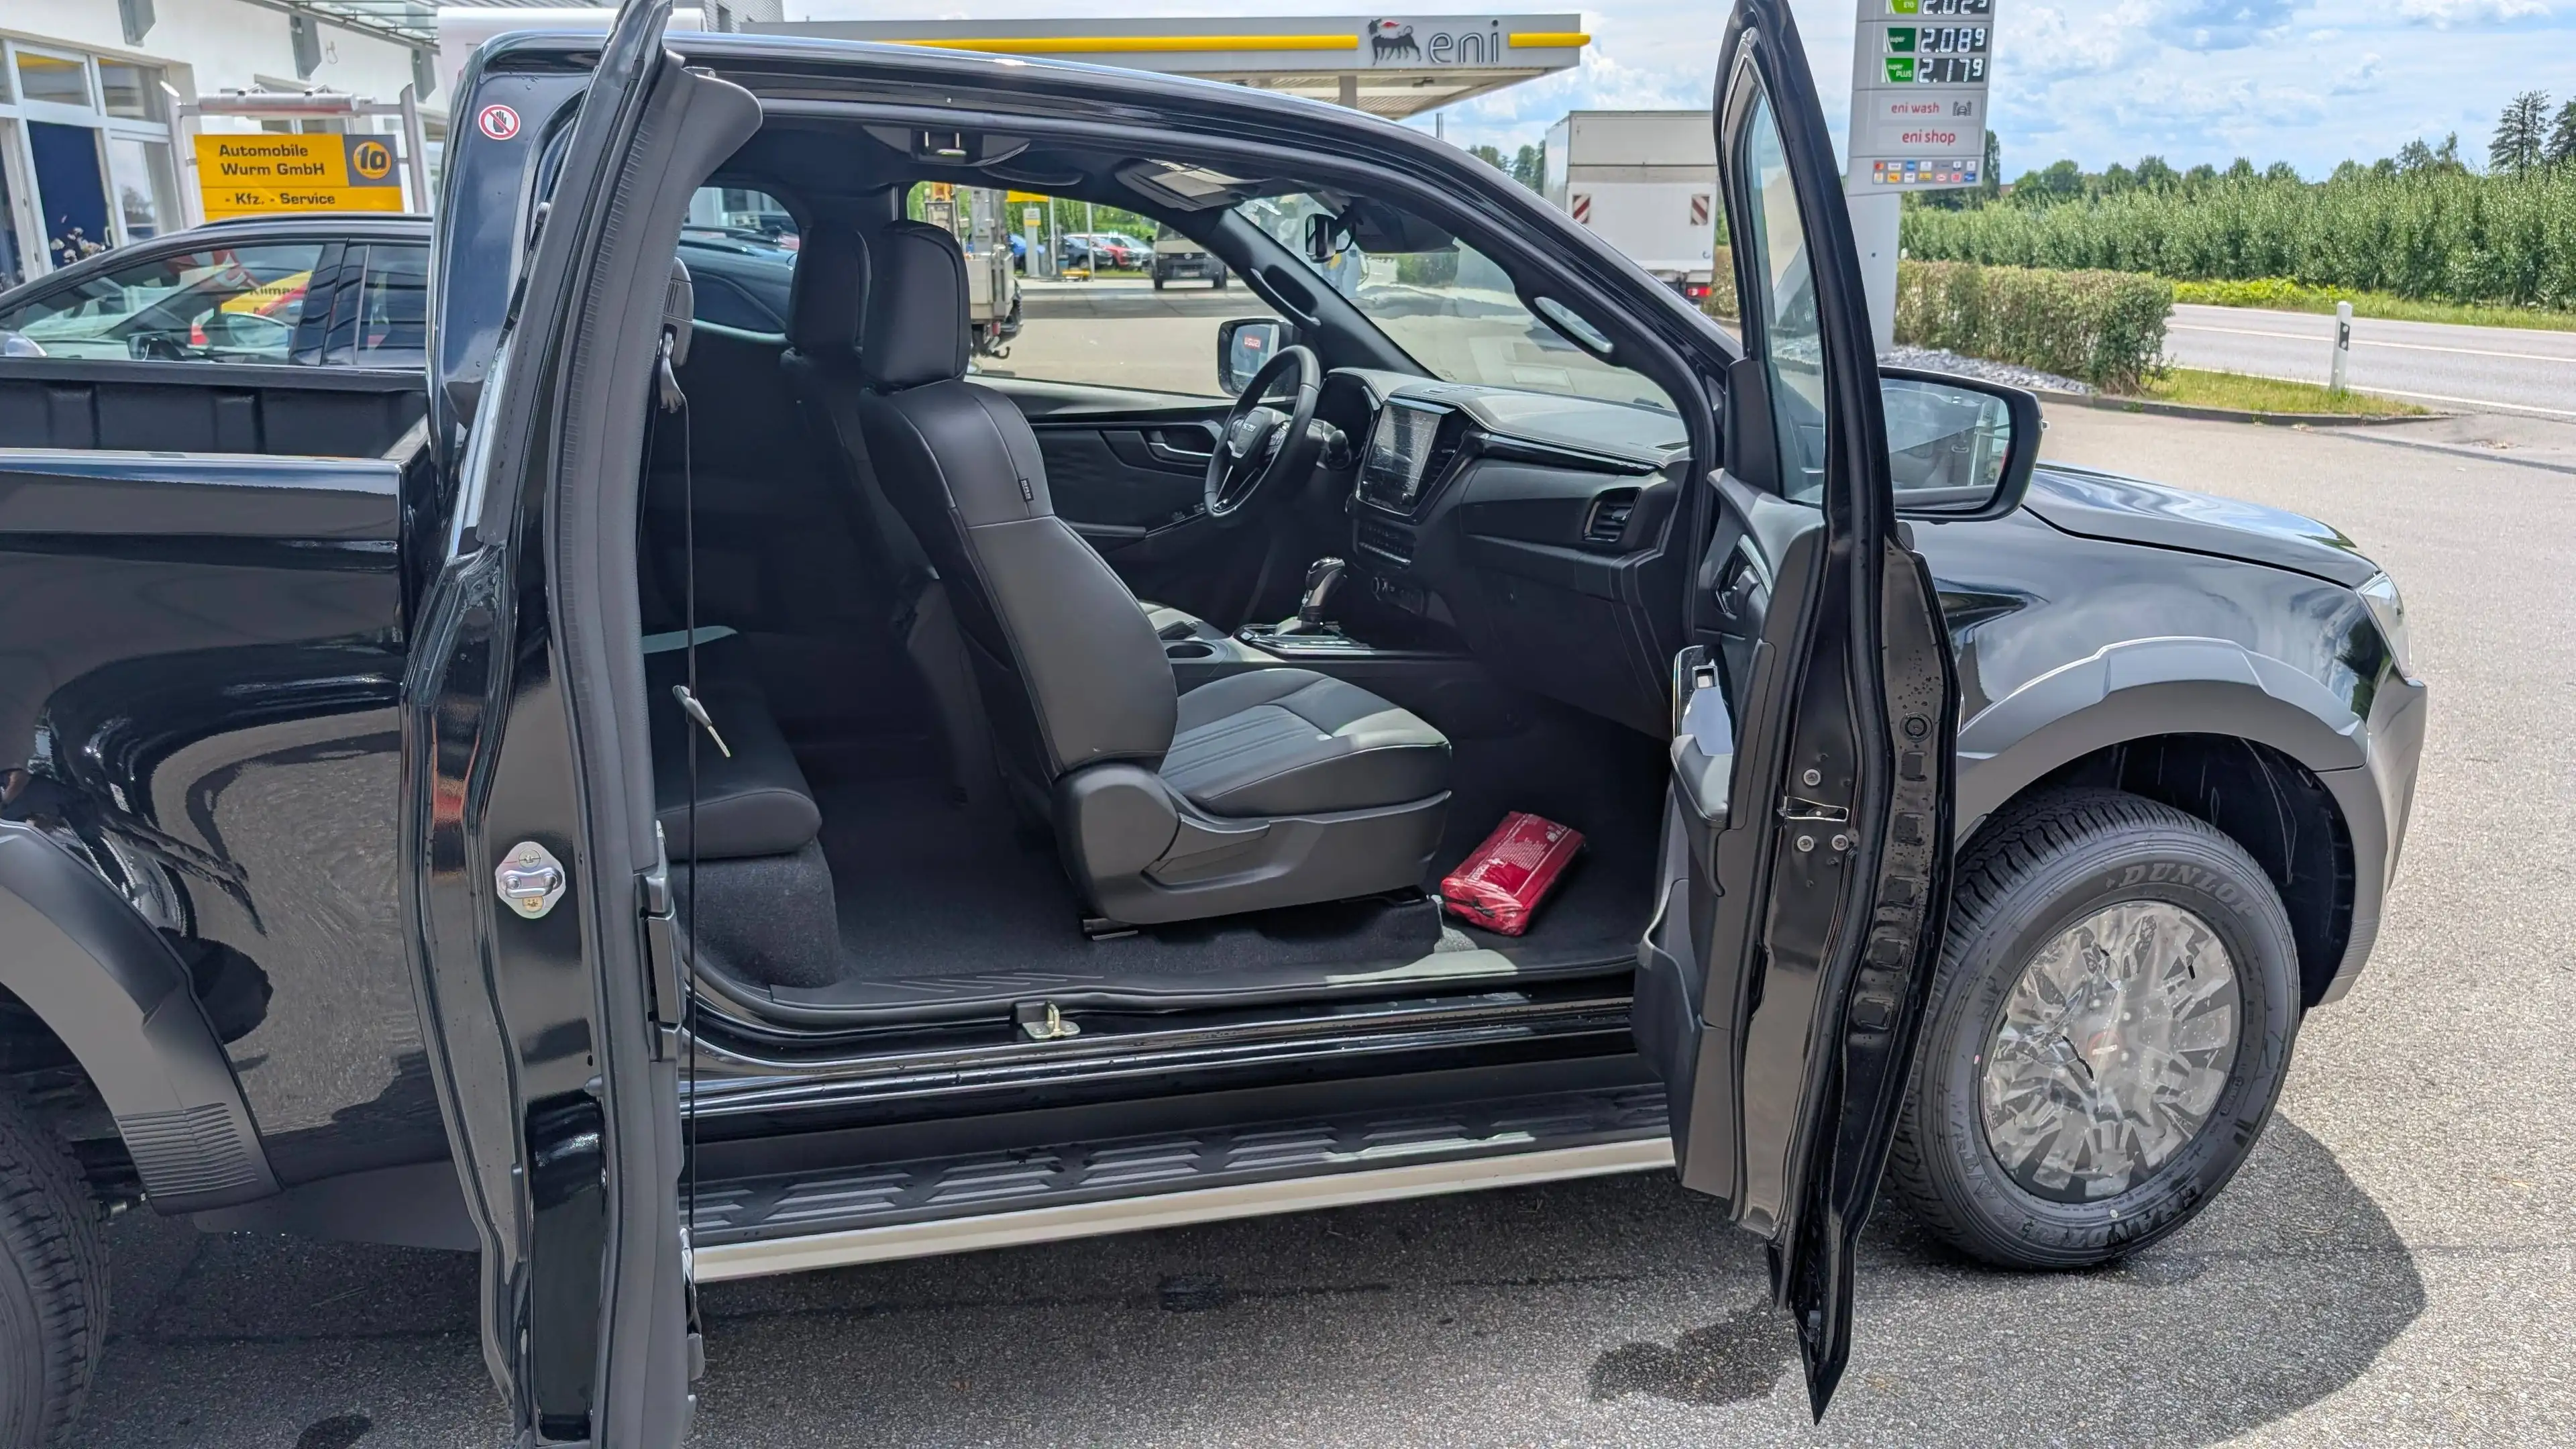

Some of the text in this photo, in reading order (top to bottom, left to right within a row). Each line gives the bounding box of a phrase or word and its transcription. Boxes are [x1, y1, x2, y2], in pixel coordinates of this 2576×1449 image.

[1428, 19, 1499, 64] eni
[1920, 28, 1986, 53] 2.089
[1918, 58, 1984, 83] 2.179
[1891, 102, 1939, 113] eni wash
[1902, 129, 1956, 146] eni shop
[219, 144, 308, 157] Automobile
[221, 162, 325, 176] Wurm GmbH
[235, 193, 265, 205] Kfz.
[280, 192, 335, 205] Service
[2118, 863, 2257, 917] DUNLOP
